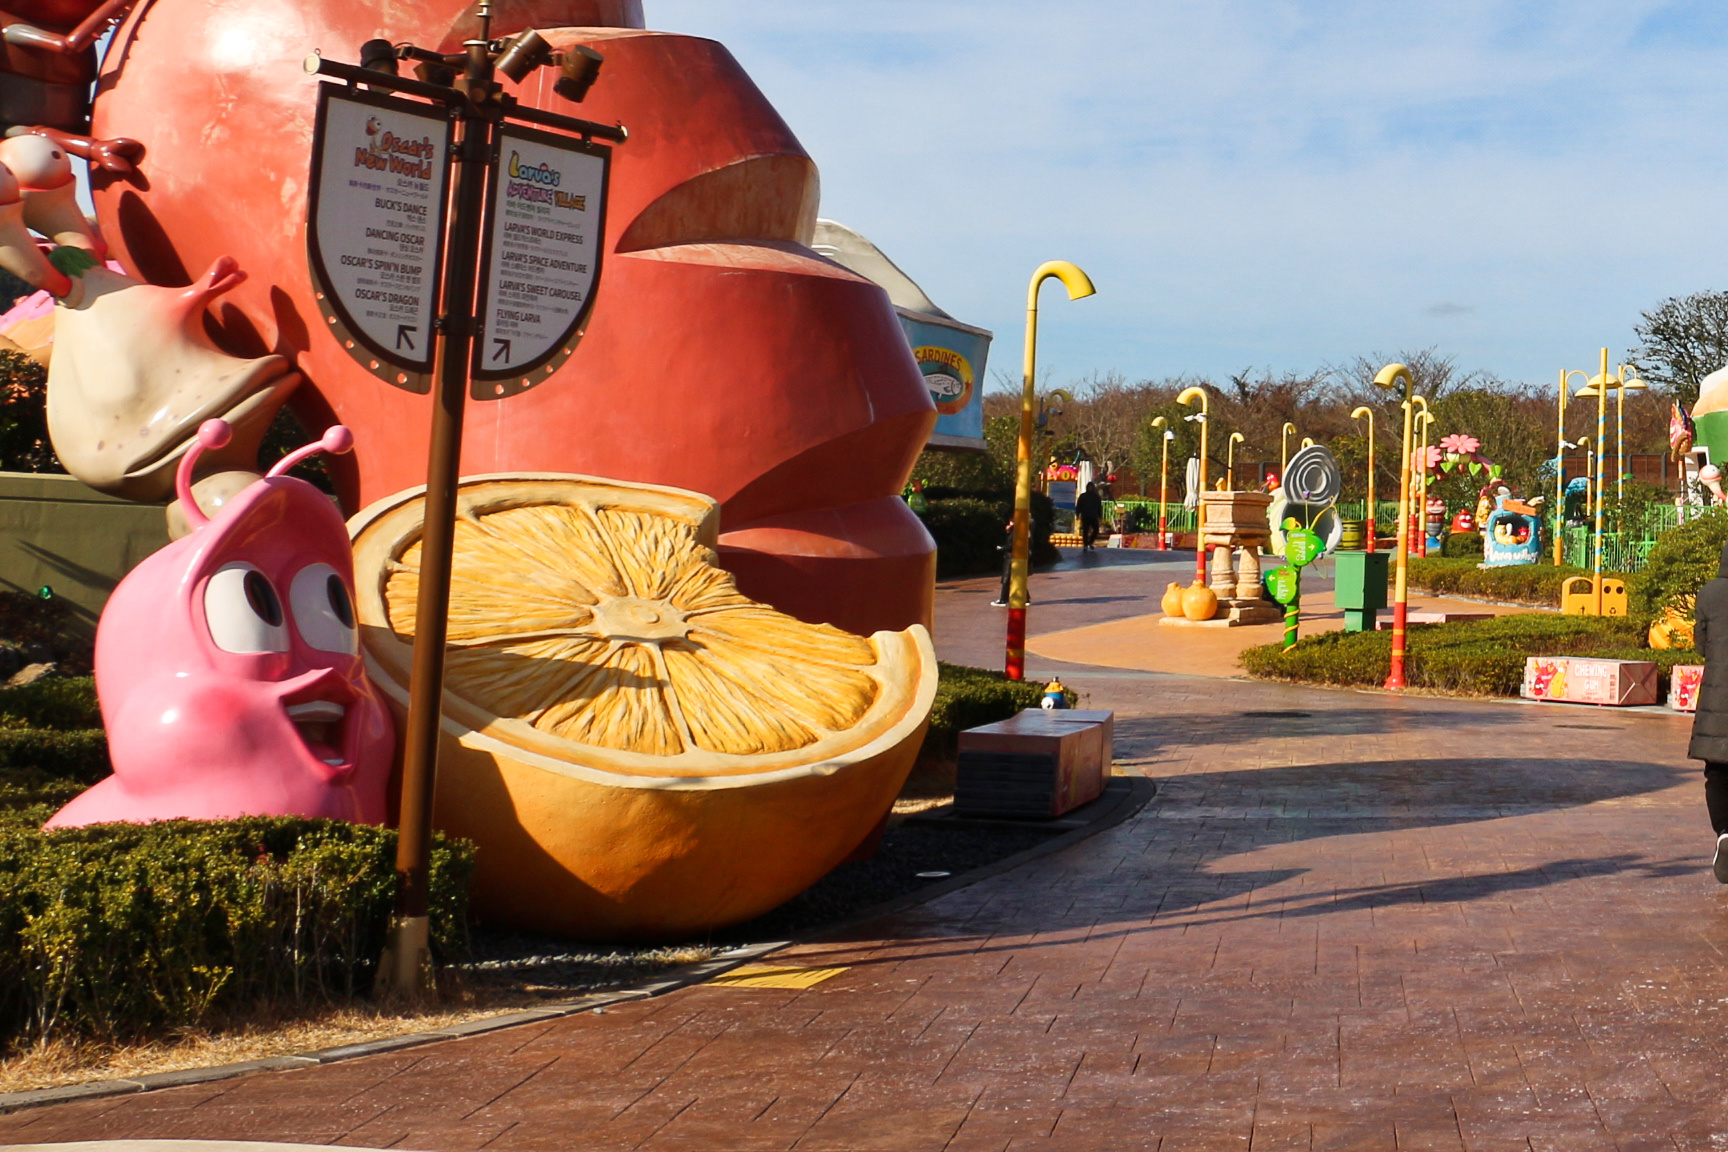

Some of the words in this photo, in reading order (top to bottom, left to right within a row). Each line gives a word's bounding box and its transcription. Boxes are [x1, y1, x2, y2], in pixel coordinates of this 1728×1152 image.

[381, 131, 434, 159] Oscar's
[354, 147, 388, 171] New
[389, 154, 432, 180] World
[509, 150, 560, 187] Larva's
[507, 180, 553, 205] ADVENTURE
[554, 190, 586, 212] VILLAGE
[375, 198, 402, 211] BUCK'S
[403, 203, 427, 216] DANCE
[366, 228, 399, 241] DANCING
[400, 234, 425, 246] OSCAR
[504, 222, 530, 234] LARVA'S
[531, 227, 554, 239] WORLD
[556, 232, 583, 244] EXPRESS
[340, 255, 373, 268] OSCAR'S
[401, 264, 422, 276] BUMP
[502, 251, 528, 264] LARVA'S
[529, 255, 549, 267] SPACE
[550, 259, 588, 273] ADVENTURE
[355, 289, 387, 302] OSCAR'S
[388, 293, 419, 306] DRAGON
[499, 280, 525, 292] LARVA'S
[526, 284, 548, 295] SWEET
[549, 288, 582, 301] CAROUSEL
[497, 309, 519, 321] FLYING
[520, 313, 540, 324] LARVA
[914, 348, 963, 372] SARDINES
[1574, 664, 1607, 677] CHEWING
[1584, 678, 1599, 690] GUM
